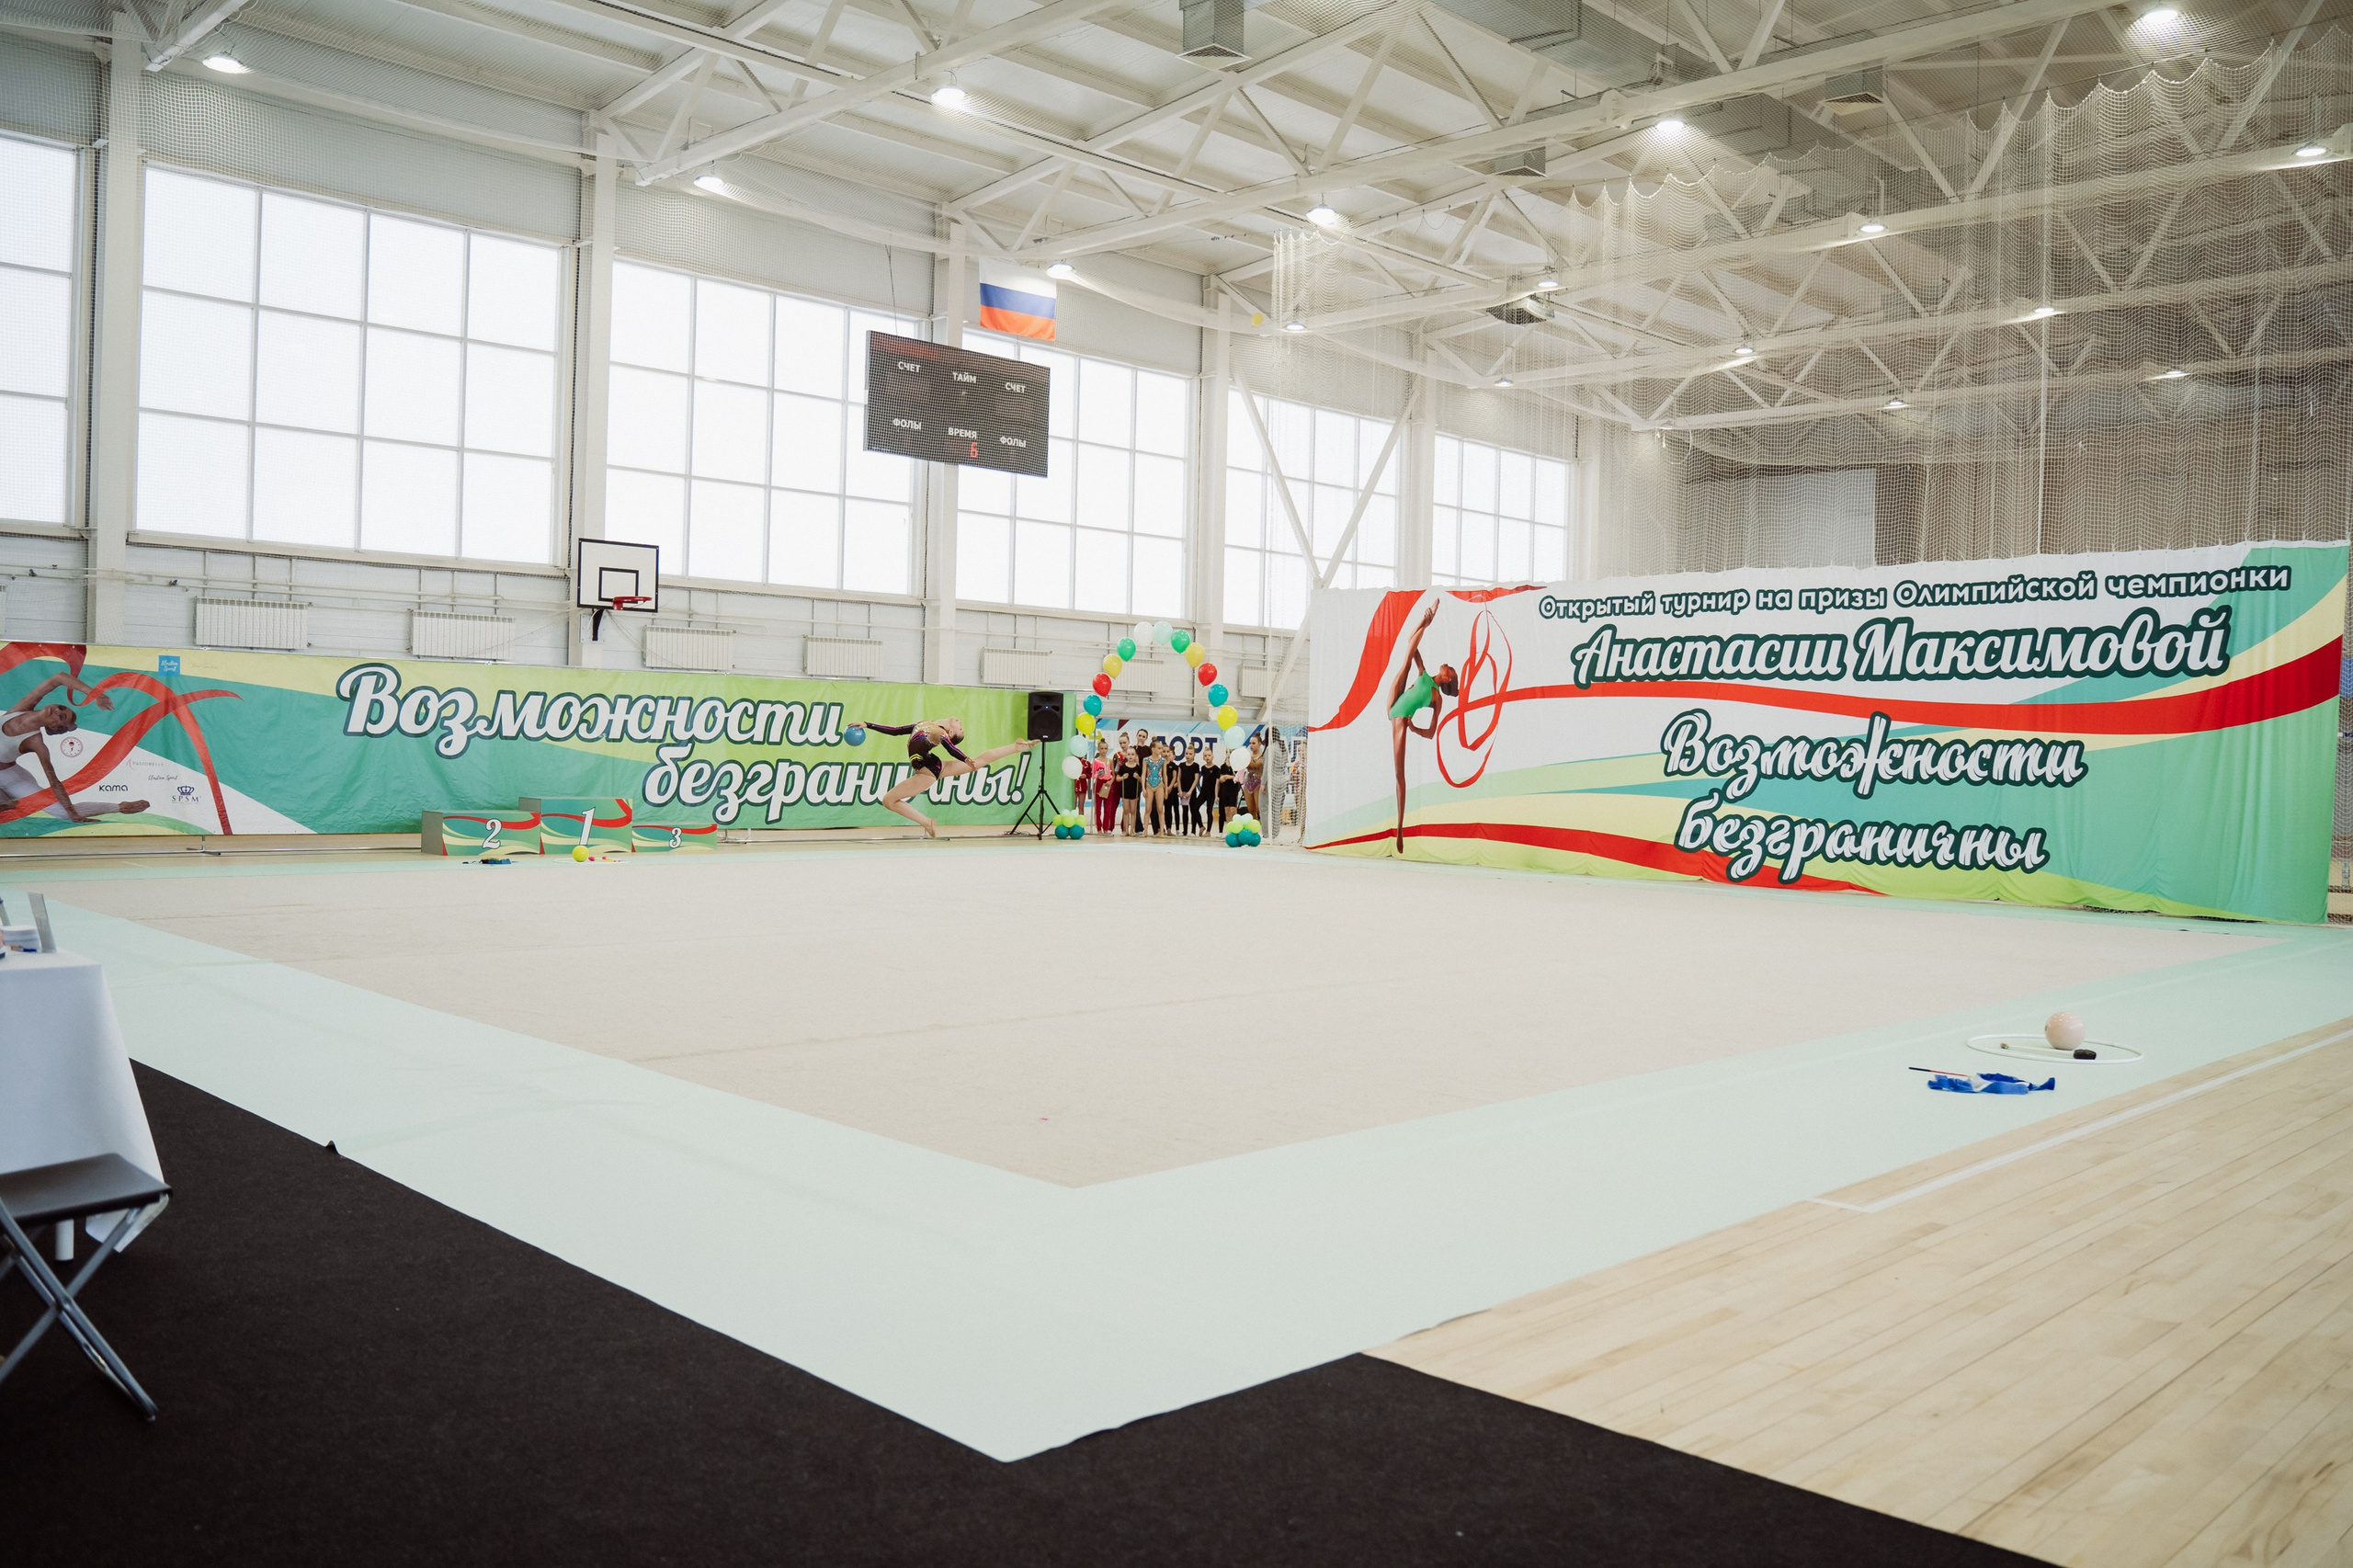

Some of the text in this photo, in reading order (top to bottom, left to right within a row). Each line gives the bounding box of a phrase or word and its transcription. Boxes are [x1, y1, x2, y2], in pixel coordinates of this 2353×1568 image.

[898, 361, 921, 372] СЧЕТ
[952, 371, 976, 383] ТАЙМ
[1006, 382, 1026, 393] СЧЕТ
[893, 418, 921, 430] ФОЛЫ
[948, 427, 977, 439] ВРЕМЯ
[971, 442, 978, 458] 6
[1000, 436, 1026, 448] ФОЛЫ
[1540, 566, 2291, 621] Открытый турнир на призы Олимпийской чемпионки
[1572, 605, 2232, 689] Анастасии Максимовой
[336, 663, 845, 759] Возможности
[1661, 709, 2088, 800] Возможности
[482, 819, 502, 849] 2
[578, 806, 596, 846] 1
[668, 827, 682, 848] 3
[1676, 790, 2050, 884] безграничны
